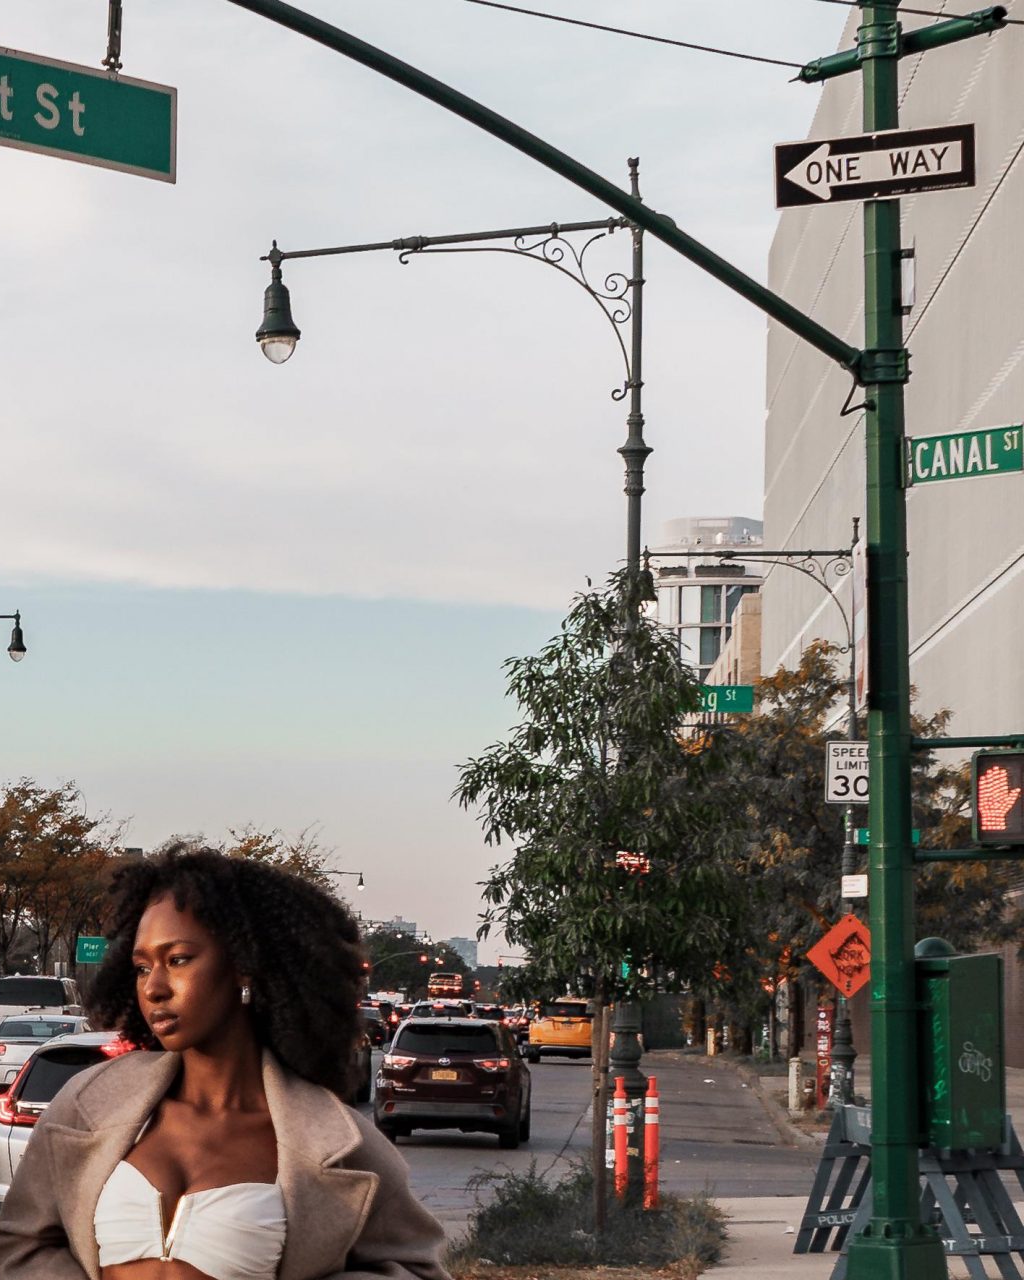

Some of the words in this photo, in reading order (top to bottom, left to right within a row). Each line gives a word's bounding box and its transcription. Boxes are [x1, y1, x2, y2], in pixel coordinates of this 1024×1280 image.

[33, 82, 86, 137] St
[806, 156, 861, 185] ONE
[888, 145, 951, 177] WAY
[915, 434, 1000, 479] CANAL
[1003, 430, 1020, 451] ST
[725, 689, 737, 701] St
[832, 747, 870, 758] SPEE
[836, 760, 869, 771] LIMIT
[832, 775, 869, 797] 30
[83, 942, 100, 950] Pier
[817, 1212, 858, 1226] POLIC
